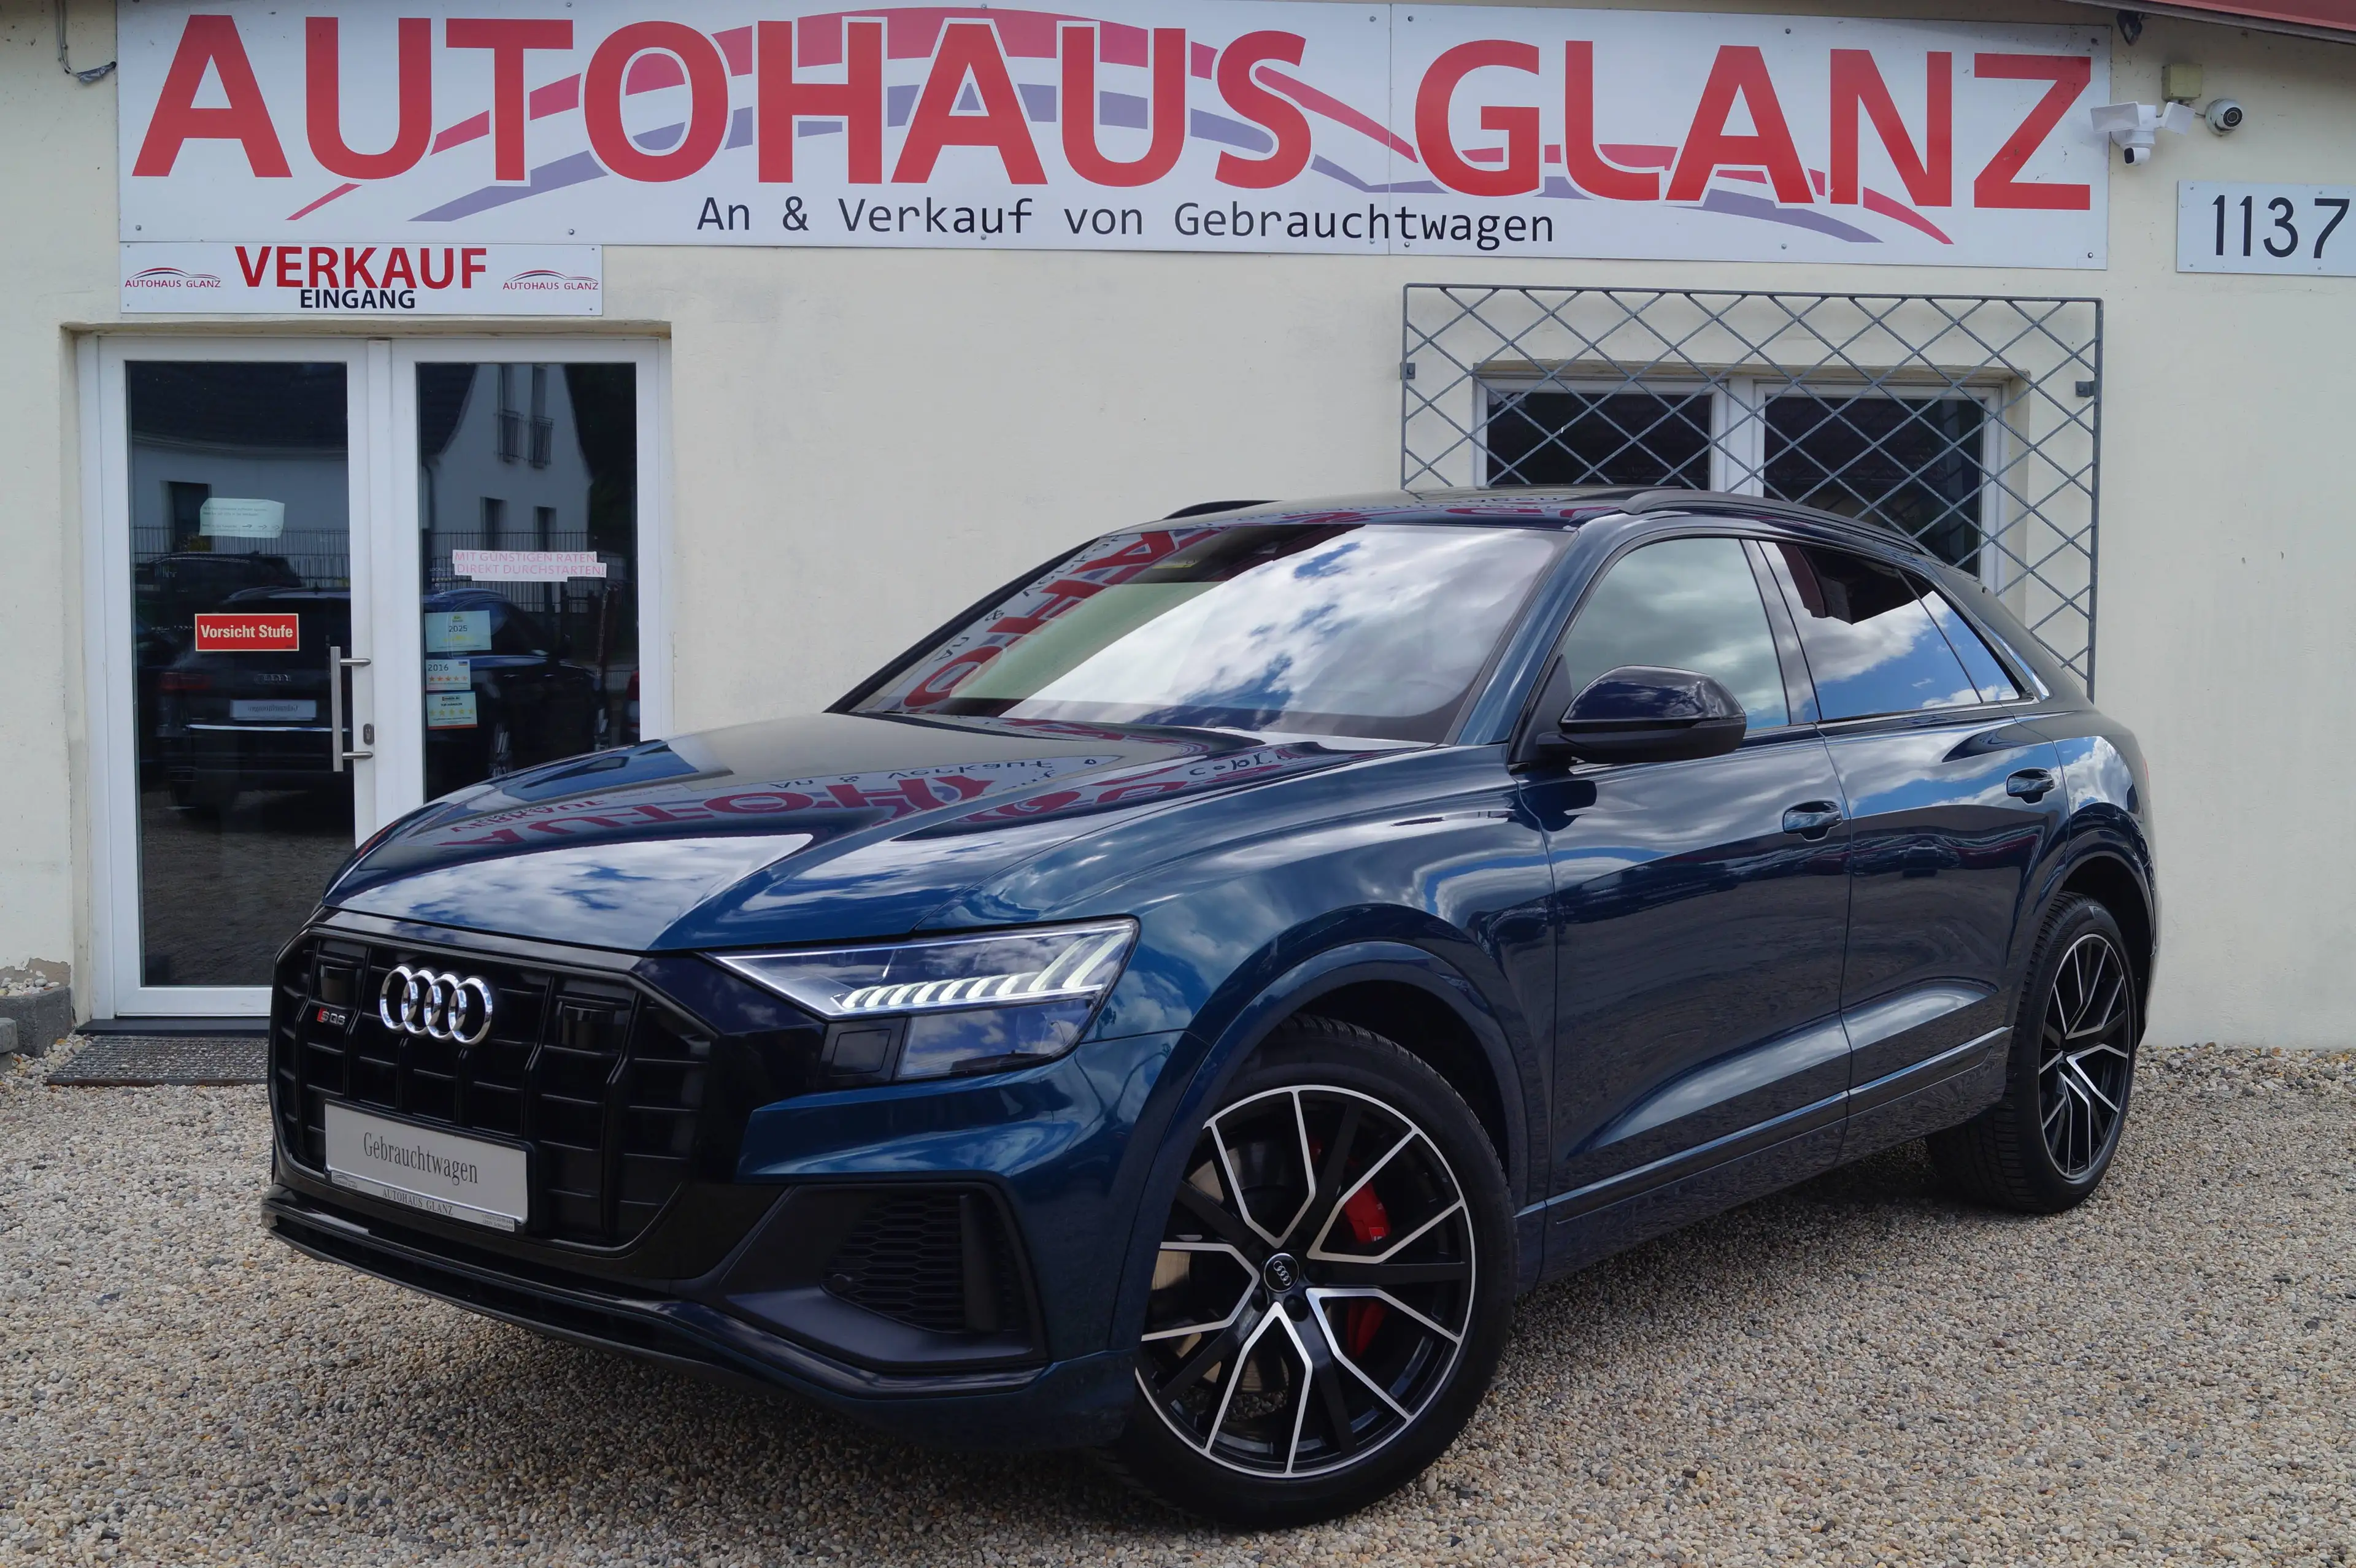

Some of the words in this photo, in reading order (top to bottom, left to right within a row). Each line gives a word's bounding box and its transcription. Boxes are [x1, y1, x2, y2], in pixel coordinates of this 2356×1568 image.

[132, 13, 1314, 190] AUTOHAUS
[1415, 39, 2092, 211] GLANZ
[697, 196, 750, 231] An
[782, 196, 810, 232] &
[837, 196, 1034, 234] Verkauf
[1063, 207, 1143, 235] von
[1174, 201, 1554, 250] Gebrauchtwagen
[2211, 194, 2350, 259] 1137
[235, 245, 487, 290] VERKAUF
[125, 280, 182, 288] AUTOHAUS
[186, 280, 221, 288] GLANZ
[502, 281, 560, 291] AUTOHAUS
[564, 282, 599, 291] GLANZ
[300, 288, 415, 309] EINGANG
[455, 551, 476, 561] MIT
[480, 550, 552, 563] GÜNSTIGEN
[556, 553, 596, 563] RATEN
[457, 563, 500, 574] DIREKT
[503, 564, 605, 575] DURCHSTARTEN!
[200, 625, 256, 639] Vorsicht
[258, 624, 293, 638] Stufe
[363, 1131, 479, 1186] Gebrauchtwagen
[382, 1188, 423, 1208] AUTOHAUS
[426, 1199, 453, 1216] GLANZ
